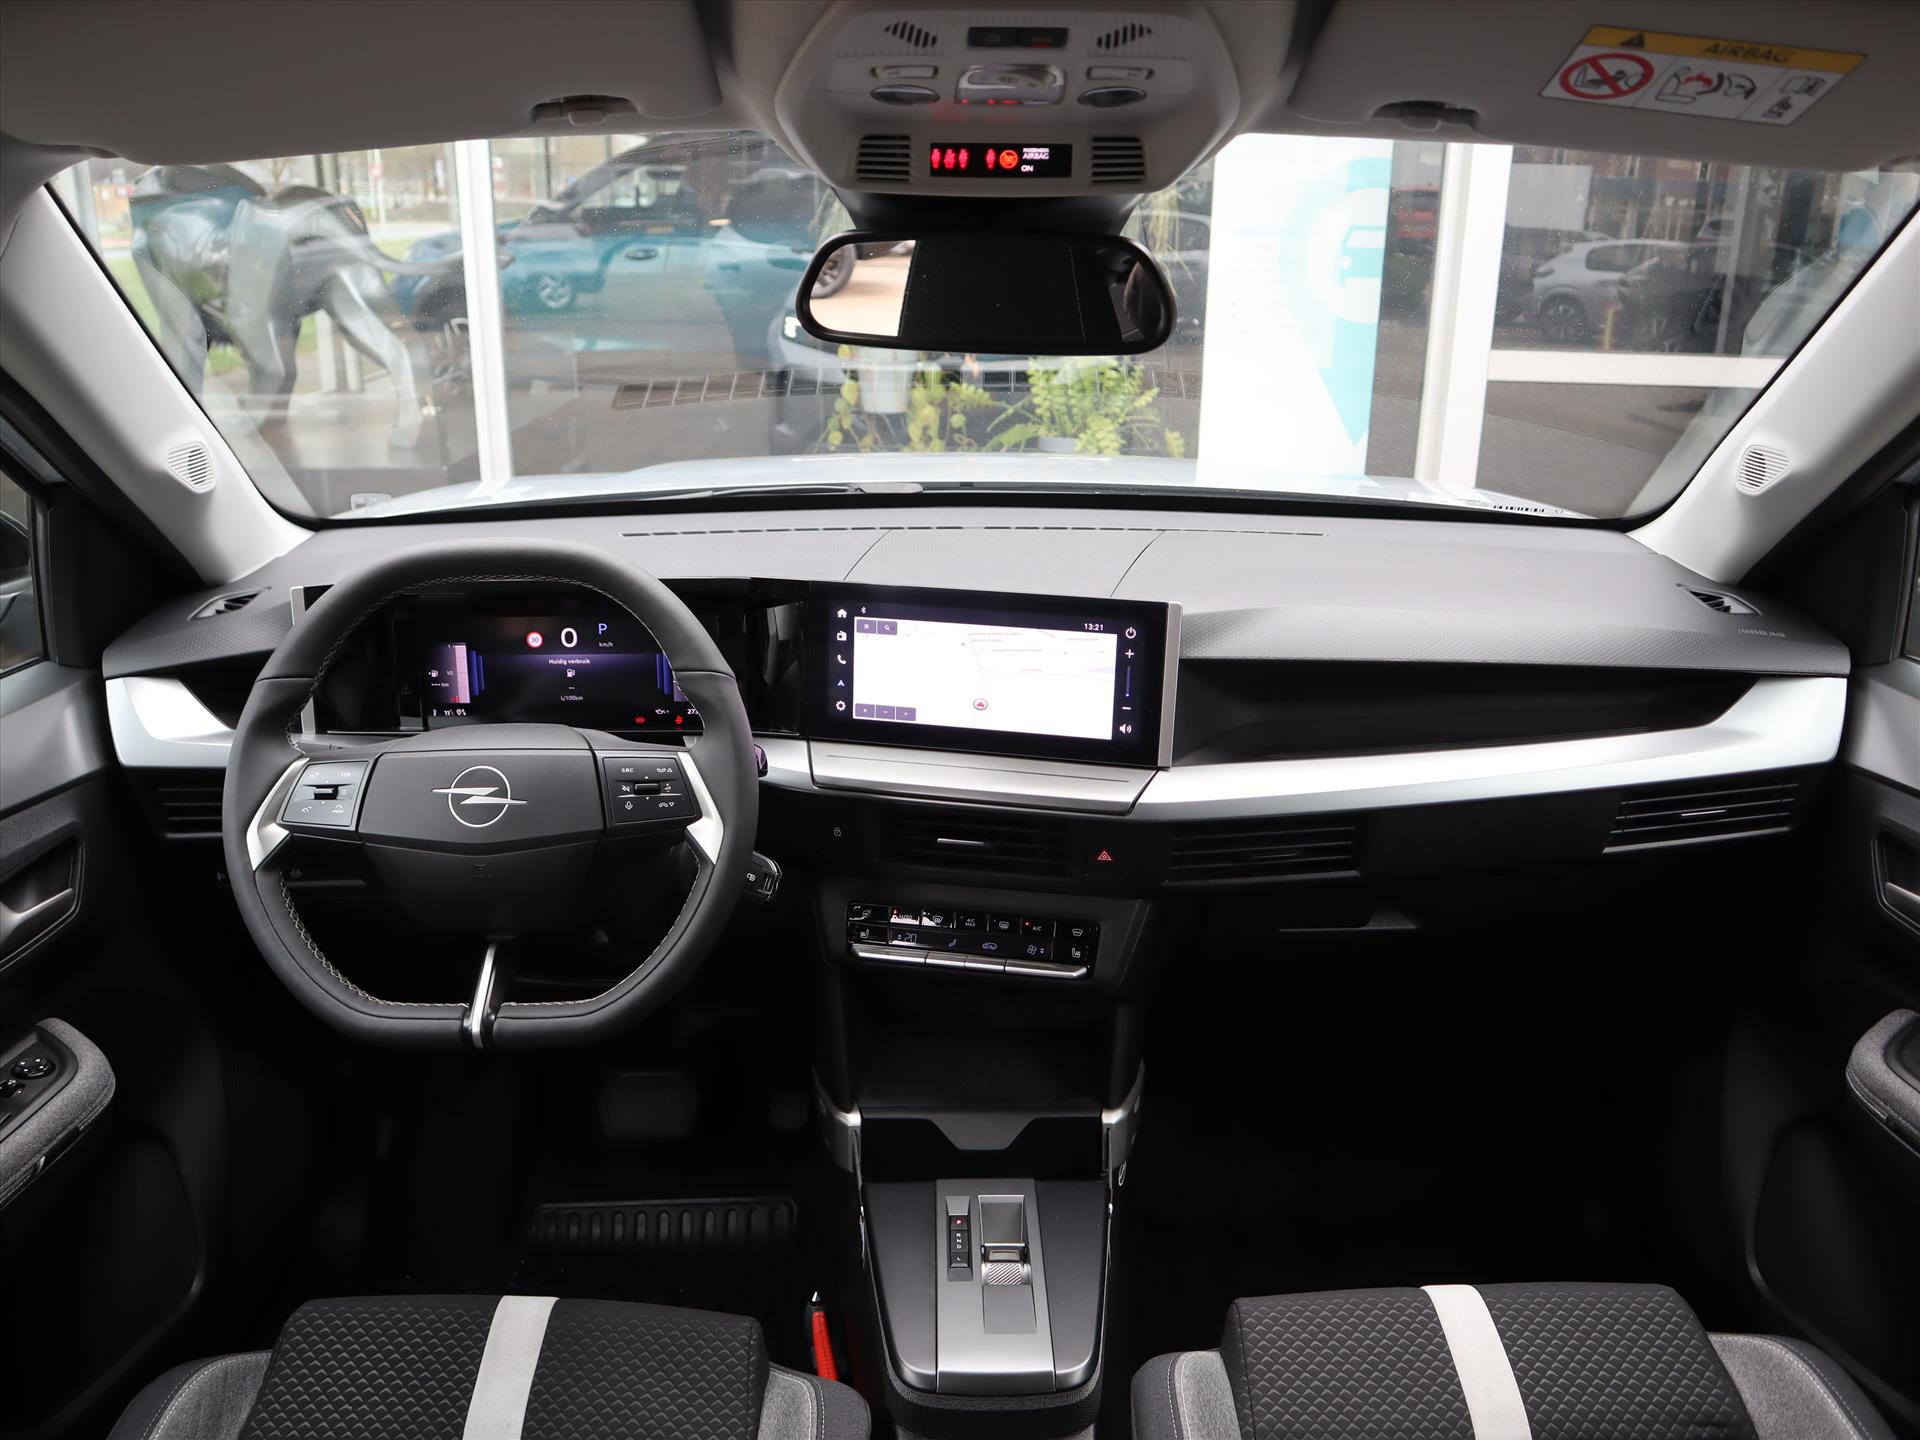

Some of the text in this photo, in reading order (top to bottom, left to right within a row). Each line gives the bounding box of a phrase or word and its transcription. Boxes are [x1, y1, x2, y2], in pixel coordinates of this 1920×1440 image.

[1703, 43, 1792, 62] AIRBAG
[1022, 152, 1049, 160] AIRBAG
[1020, 164, 1034, 172] ON
[598, 623, 607, 635] P
[1084, 622, 1104, 631] 13:21
[560, 627, 578, 648] 0
